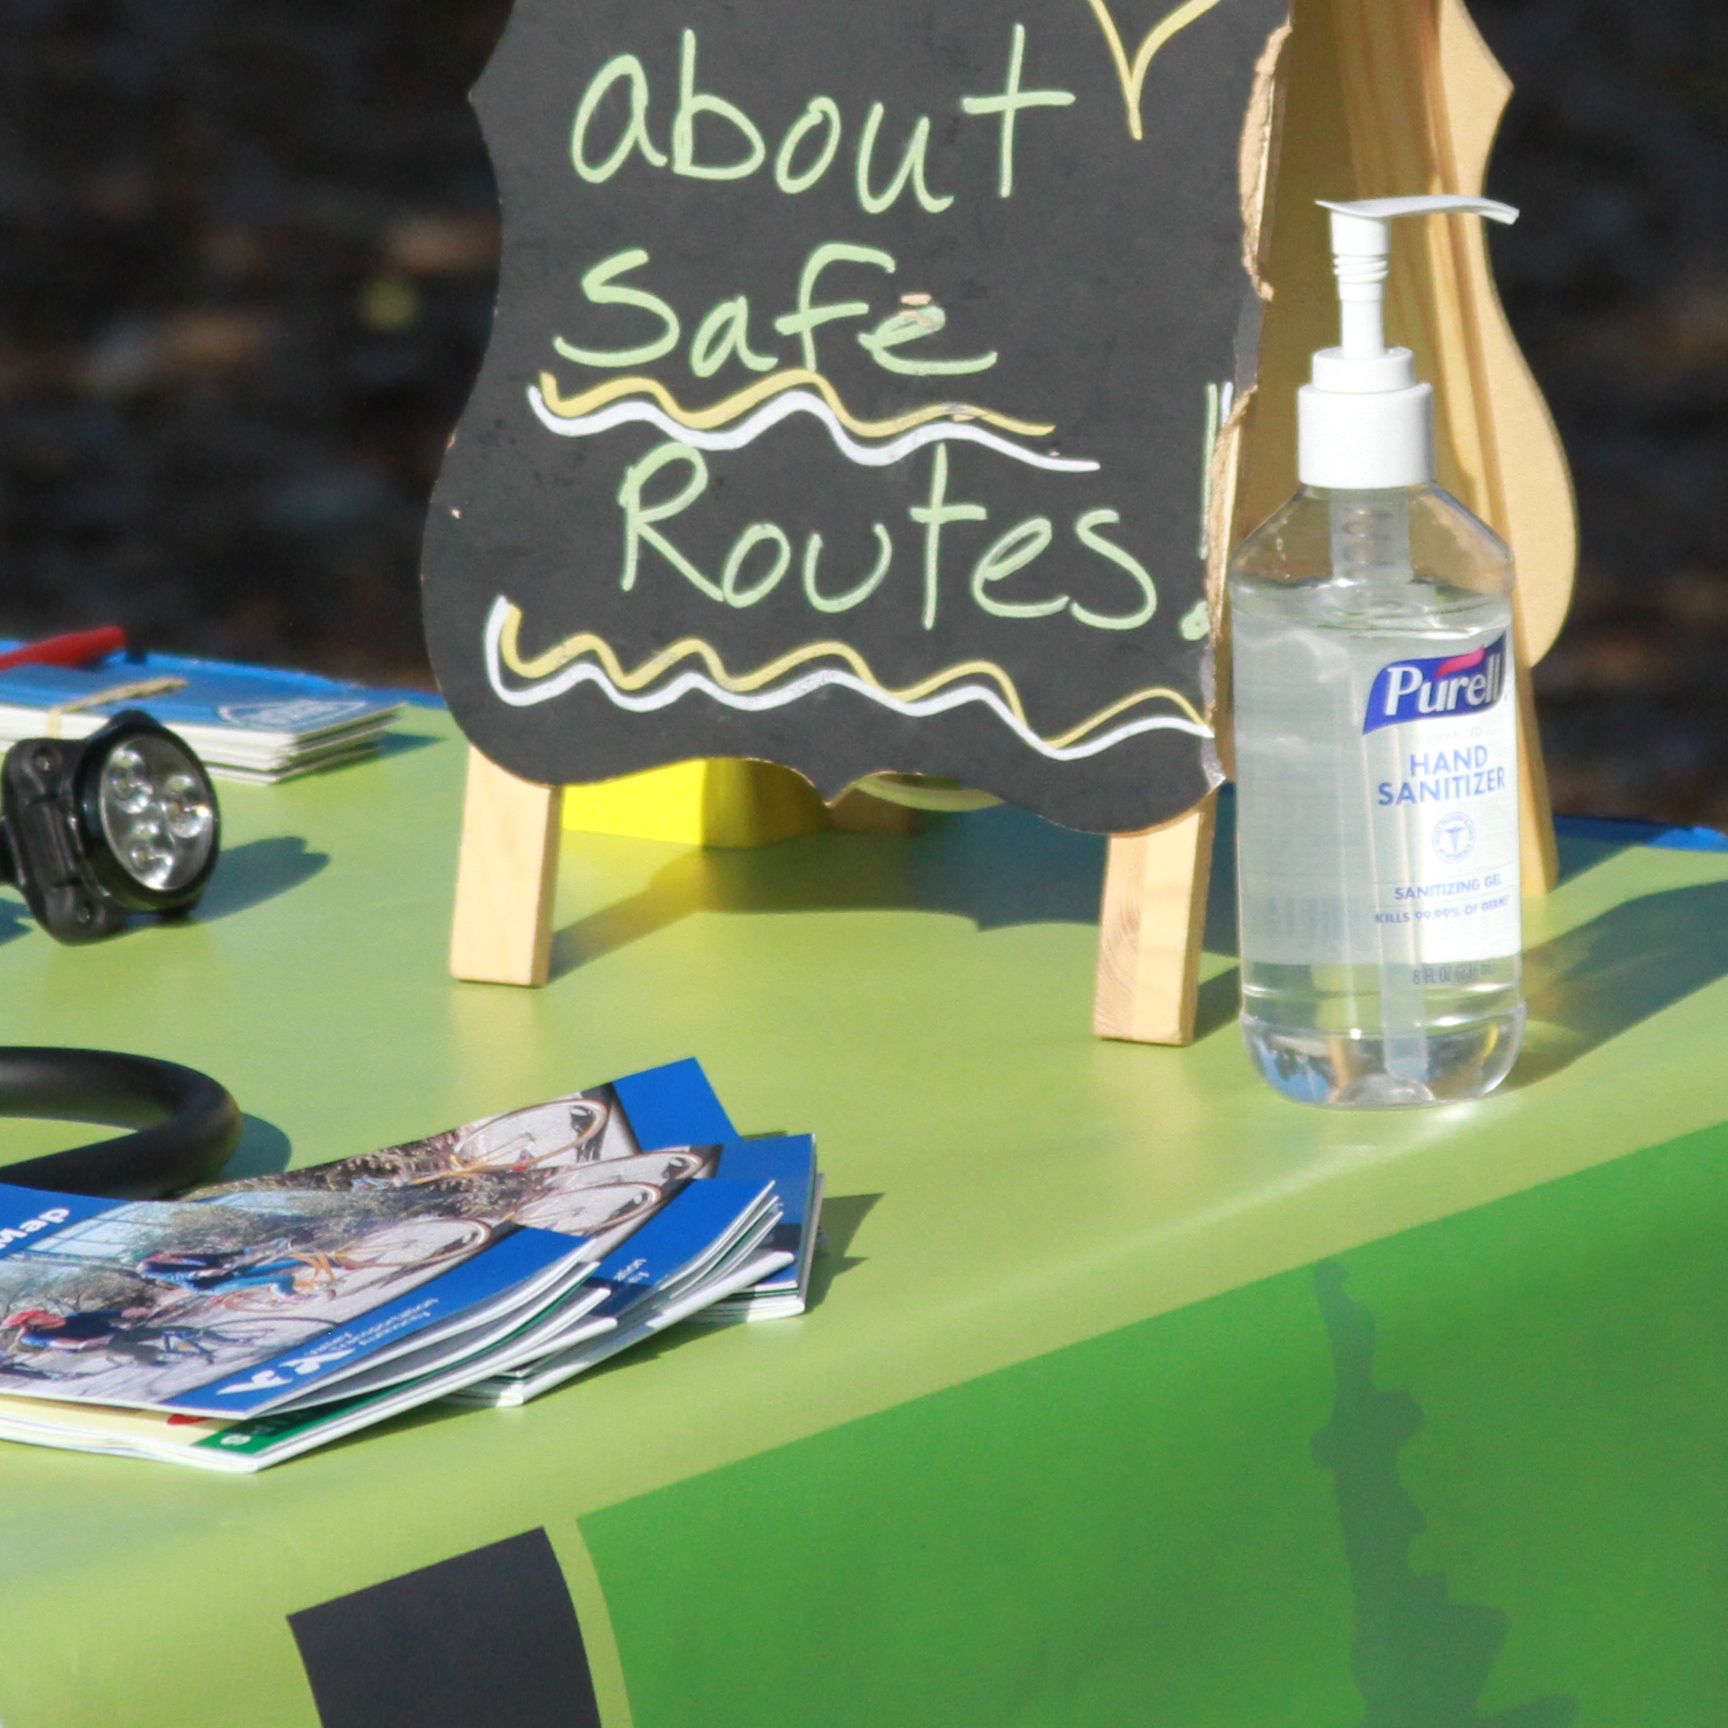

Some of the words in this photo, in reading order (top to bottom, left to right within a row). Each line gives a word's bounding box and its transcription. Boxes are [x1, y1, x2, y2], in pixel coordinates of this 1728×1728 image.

[571, 24, 1076, 213] about
[554, 242, 998, 378] Safe
[1385, 652, 1502, 716] Purell
[1410, 745, 1488, 777] HAND
[1377, 766, 1506, 806] SANITIZER
[1394, 879, 1480, 900] SANITIZING
[1374, 912, 1411, 924] KILLS
[328, 1297, 440, 1352] Transportation
